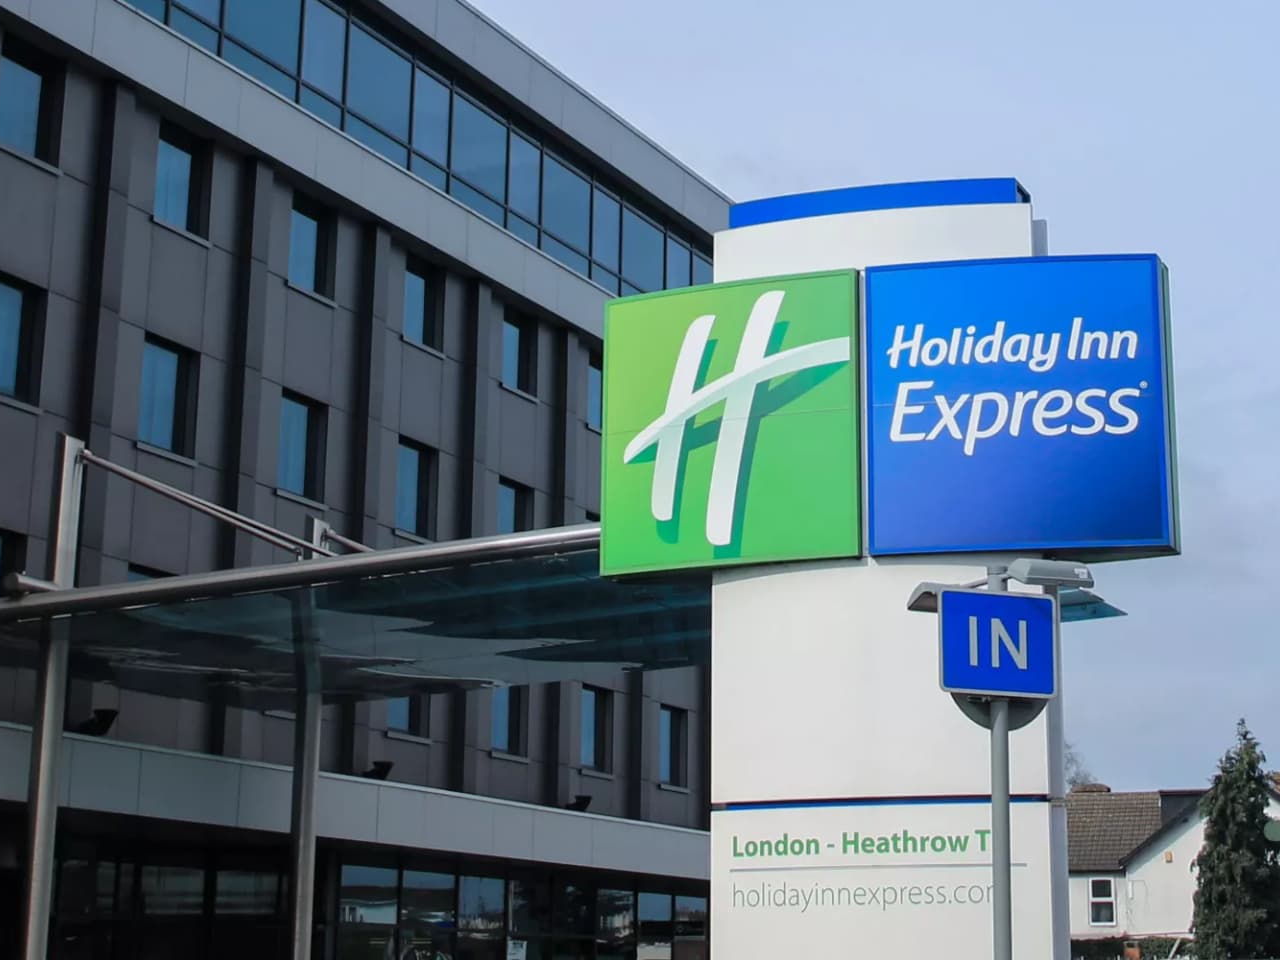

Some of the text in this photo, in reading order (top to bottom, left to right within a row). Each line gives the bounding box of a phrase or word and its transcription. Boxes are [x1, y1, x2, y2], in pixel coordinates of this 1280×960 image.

[886, 317, 1138, 372] Holiday Inn
[889, 380, 1141, 456] Express
[968, 615, 1028, 670] IN
[732, 833, 820, 857] London
[842, 829, 969, 855] Heathrow
